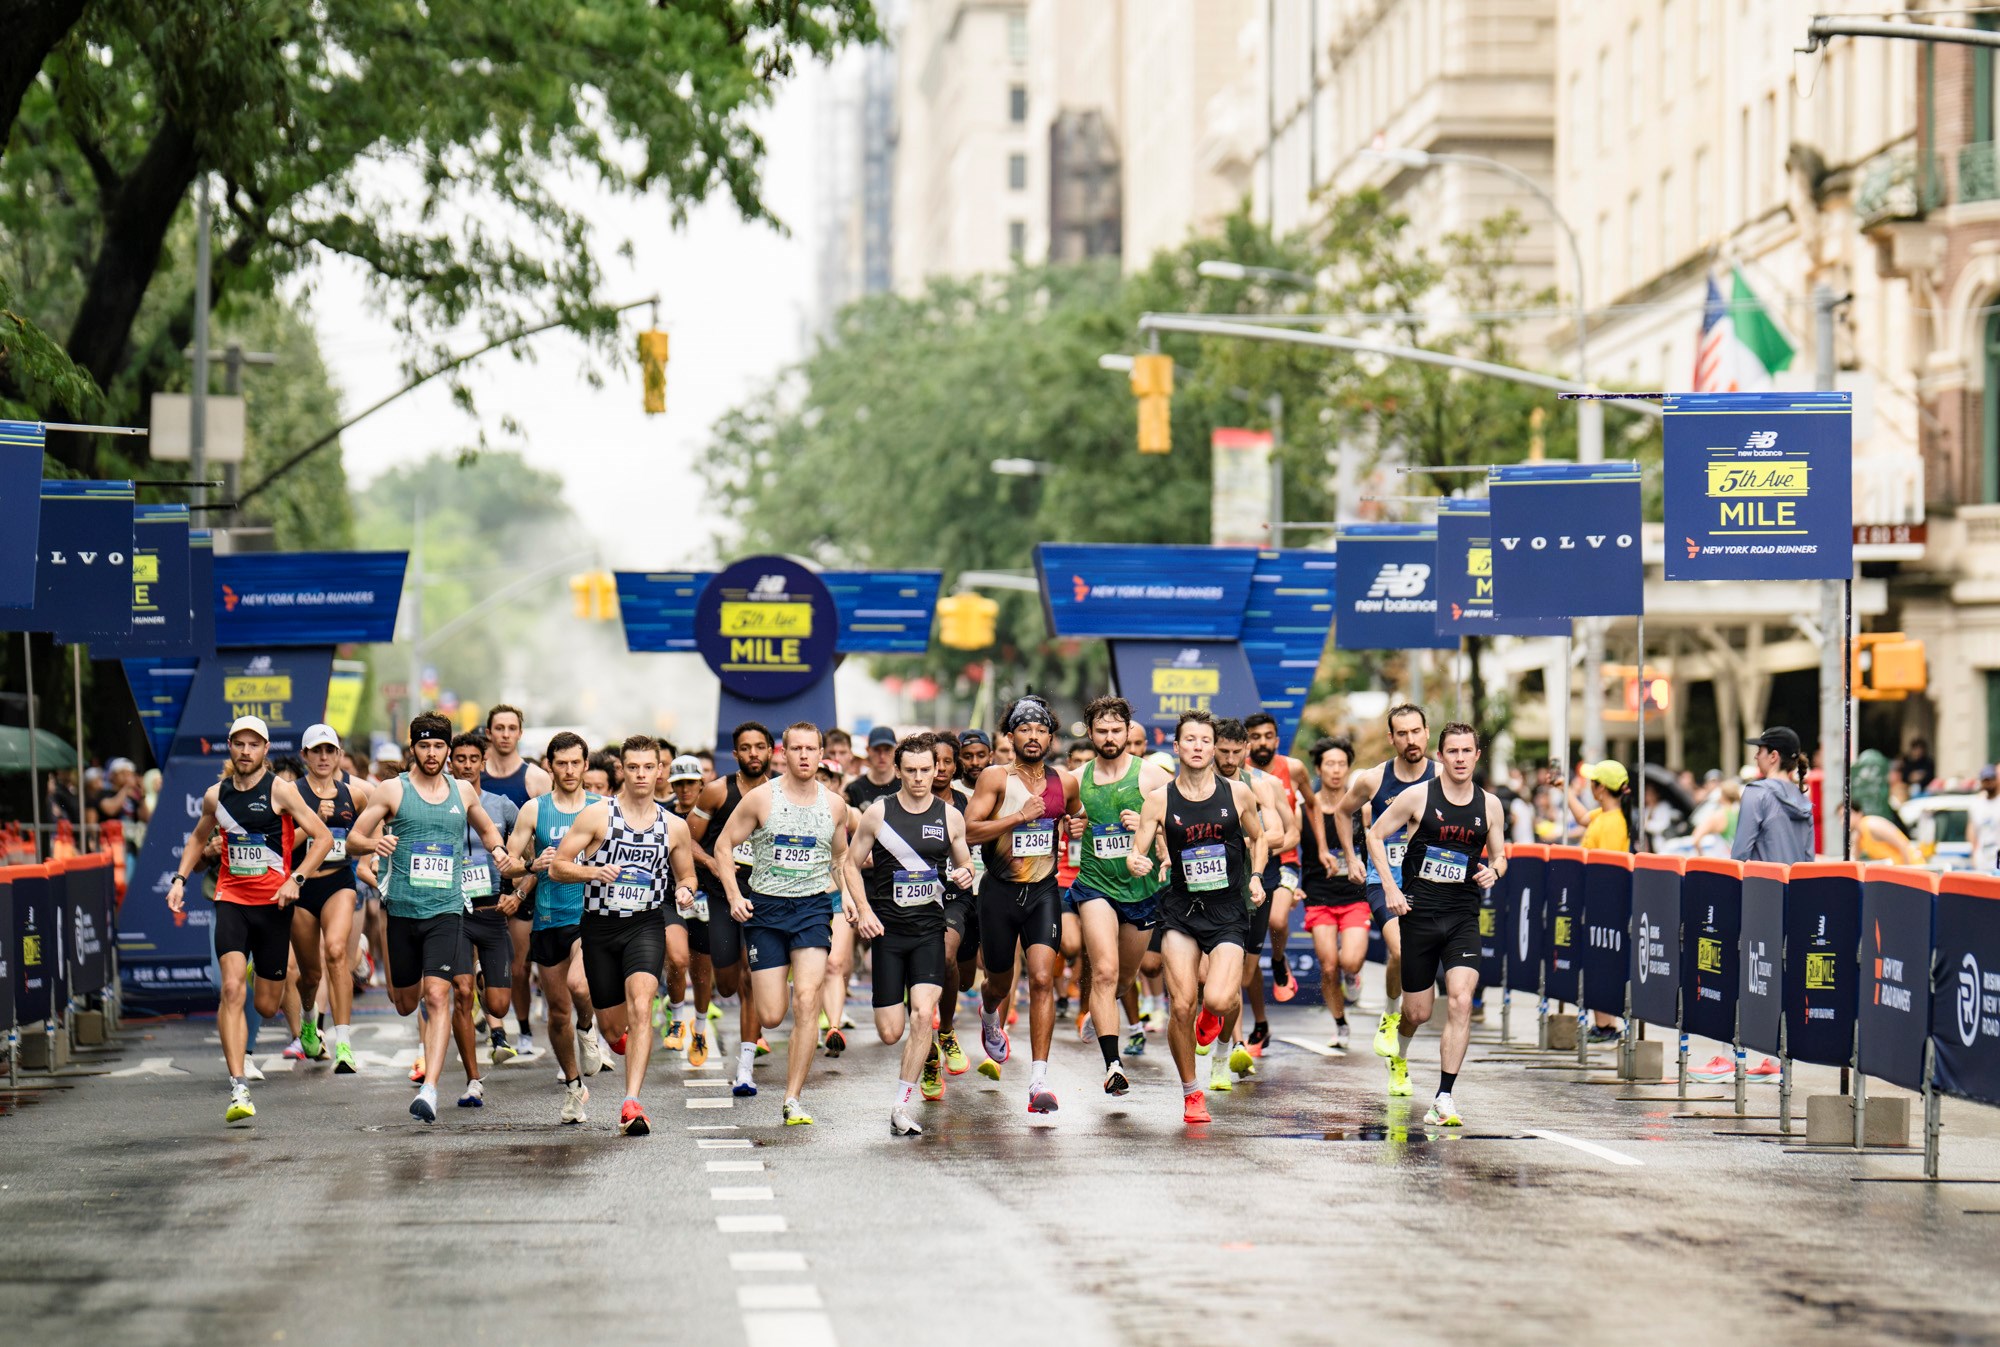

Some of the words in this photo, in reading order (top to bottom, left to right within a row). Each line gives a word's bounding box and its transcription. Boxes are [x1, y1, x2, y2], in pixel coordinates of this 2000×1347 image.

[1719, 470, 1757, 492] 5th
[1720, 502, 1796, 526] MILE
[1500, 535, 1633, 550] VOLVO
[1702, 546, 1726, 555] NEW
[1725, 546, 1749, 554] YORK
[1750, 545, 1775, 554] ROAD
[1776, 545, 1818, 553] RUNNERS
[241, 594, 266, 606] NEW
[266, 593, 296, 606] YORK
[296, 592, 325, 605] ROAD
[325, 591, 375, 604] RUNNERS
[1091, 585, 1116, 598] NEW
[1354, 599, 1383, 612] new
[1384, 597, 1437, 612] balance
[731, 639, 800, 663] MILE
[1160, 695, 1211, 713] MILE
[924, 828, 942, 837] NBR
[1185, 823, 1223, 842] NYAC
[1439, 825, 1475, 845] NYAC
[1015, 837, 1022, 848] E
[1025, 833, 1050, 847] 2364
[1096, 840, 1102, 851] E
[1106, 835, 1131, 850] 4017
[230, 847, 235, 859] E
[237, 847, 262, 859] 1760
[618, 847, 654, 862] NBR
[774, 849, 782, 860] E
[785, 848, 810, 862] 2925
[1390, 848, 1396, 859] E
[413, 859, 419, 869] E
[425, 858, 448, 871] 3761
[1185, 864, 1192, 876] E
[1196, 860, 1223, 875] 3541
[1424, 861, 1432, 873] E
[1435, 863, 1461, 880] 4163
[462, 868, 485, 883] 3911
[607, 887, 614, 898] E
[619, 886, 645, 900] 4047
[896, 887, 902, 898] E
[907, 883, 933, 897] 2500
[1590, 925, 1621, 952] VOLVO
